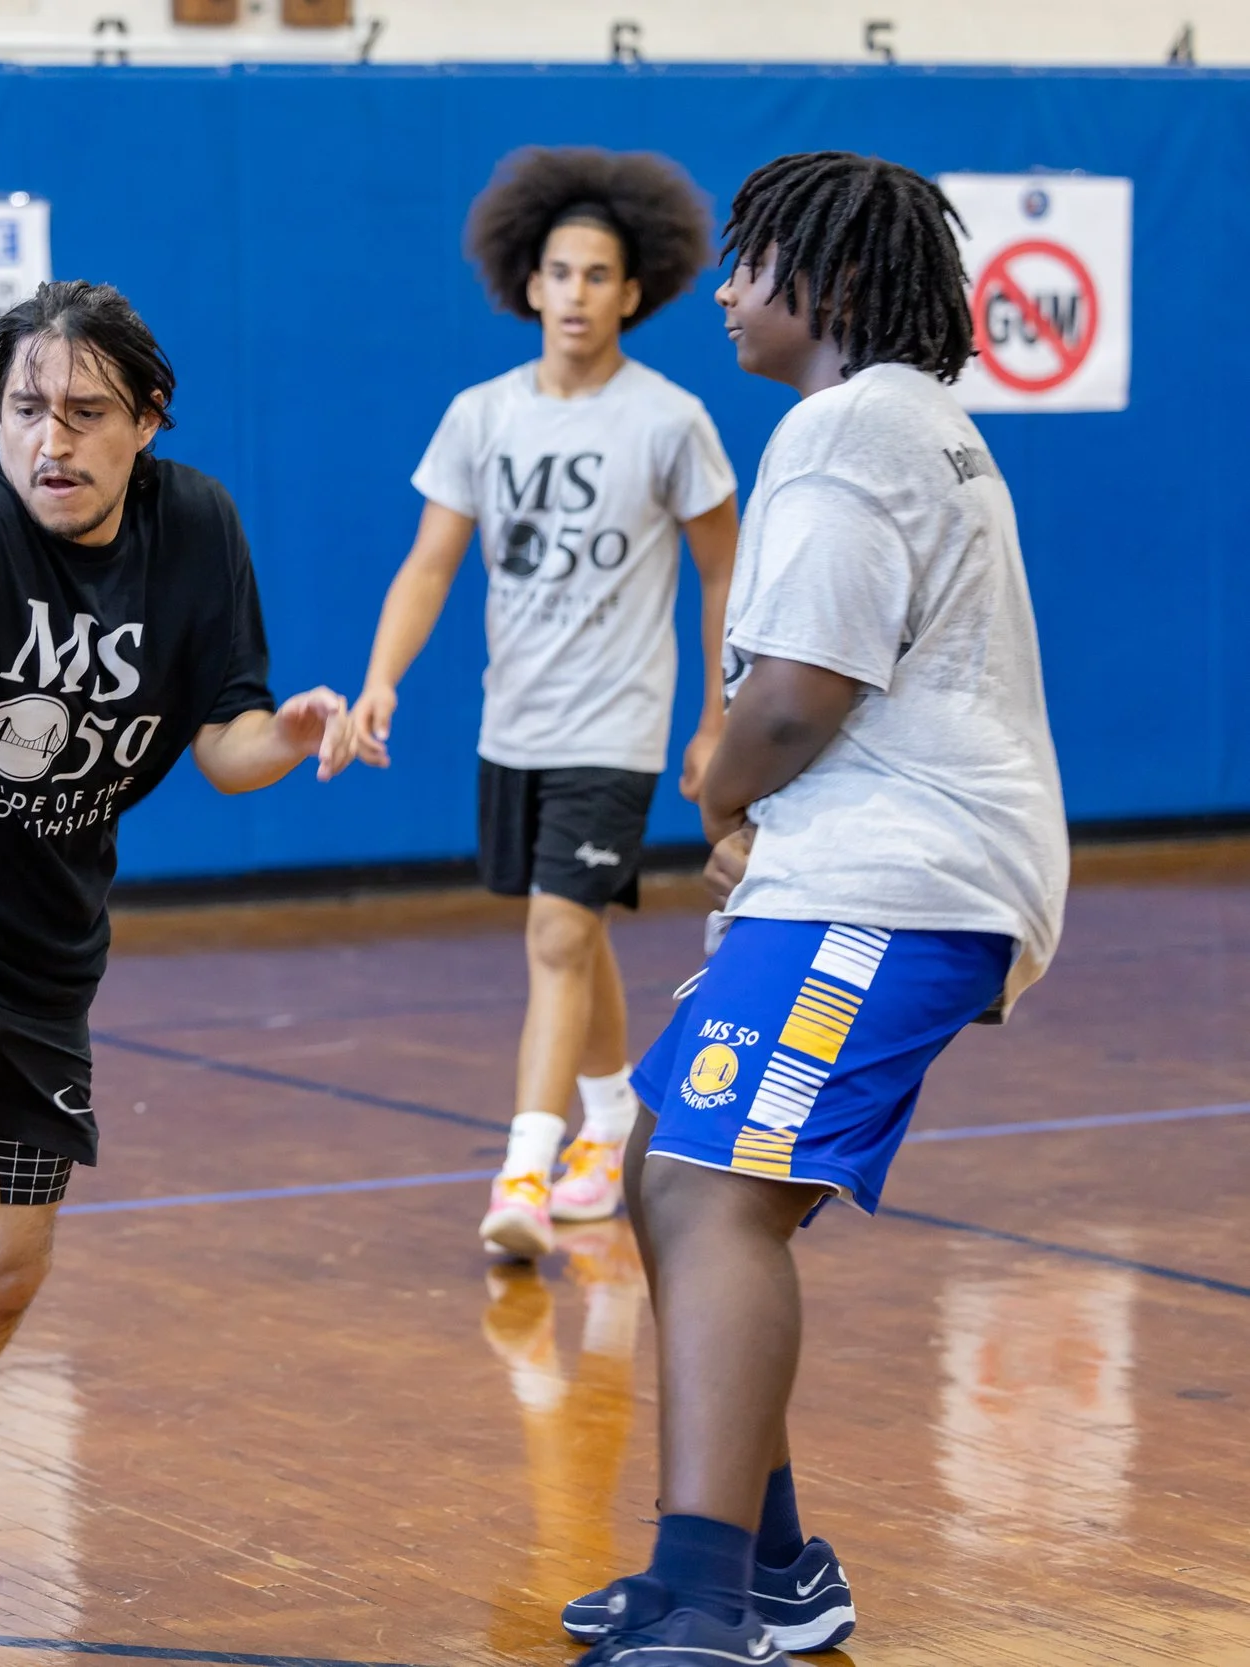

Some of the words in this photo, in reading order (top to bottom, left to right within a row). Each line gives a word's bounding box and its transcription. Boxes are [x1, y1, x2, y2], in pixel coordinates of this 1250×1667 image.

[864, 20, 896, 66] 5
[498, 452, 603, 514] MS
[540, 524, 629, 583] 50
[0, 598, 144, 703] MS
[52, 711, 162, 783] 50
[56, 791, 84, 814] OF
[93, 776, 134, 806] THE
[698, 1019, 735, 1041] MS
[727, 1026, 760, 1047] 50
[680, 1076, 737, 1110] WARRIORS
